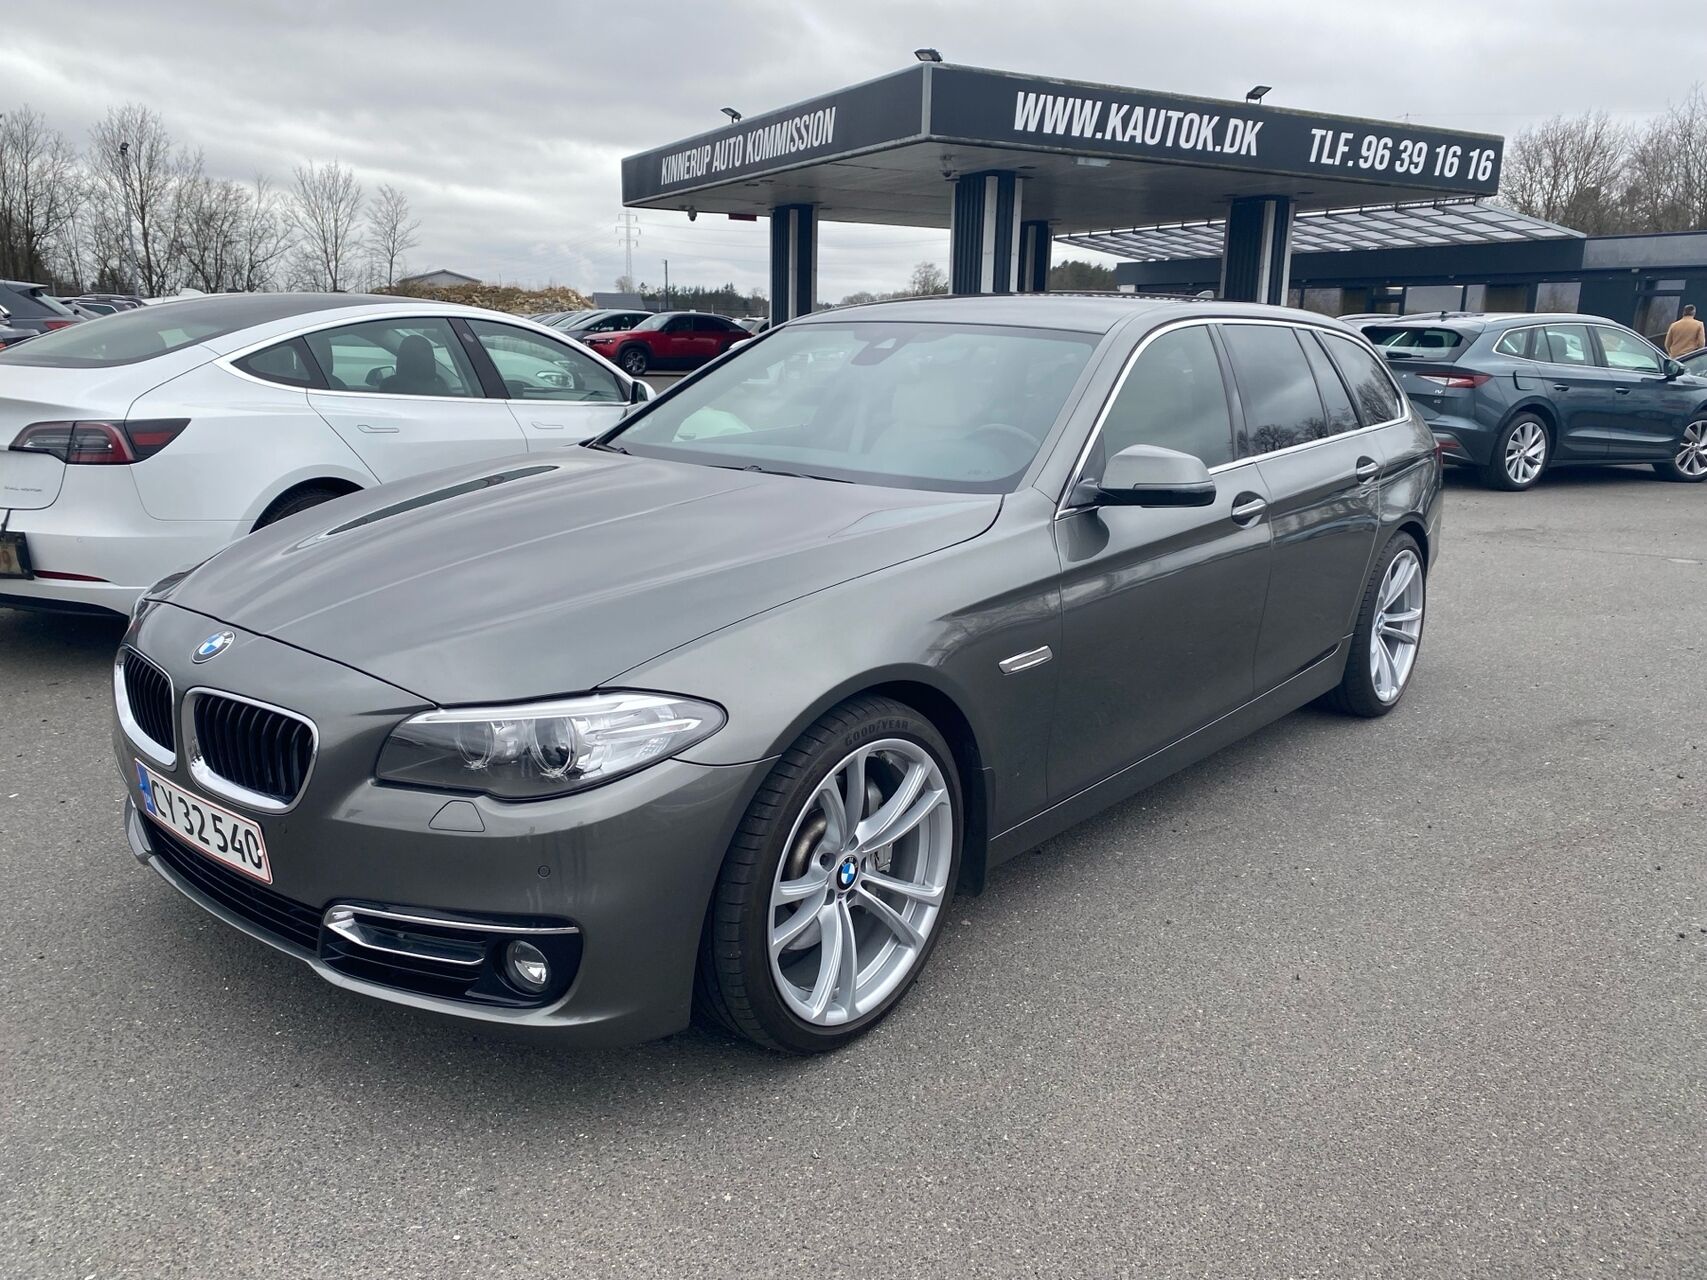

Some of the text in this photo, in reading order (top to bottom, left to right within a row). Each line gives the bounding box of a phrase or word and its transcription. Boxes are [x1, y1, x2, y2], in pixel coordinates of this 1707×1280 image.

[660, 106, 837, 185] KINNERUP AUTO KOMMISSION
[1013, 91, 1495, 182] WWW.KAUTOK.DK TLF. 96 39 16 16
[845, 719, 909, 746] GOODYEAR
[151, 779, 263, 870] CY 32 540
